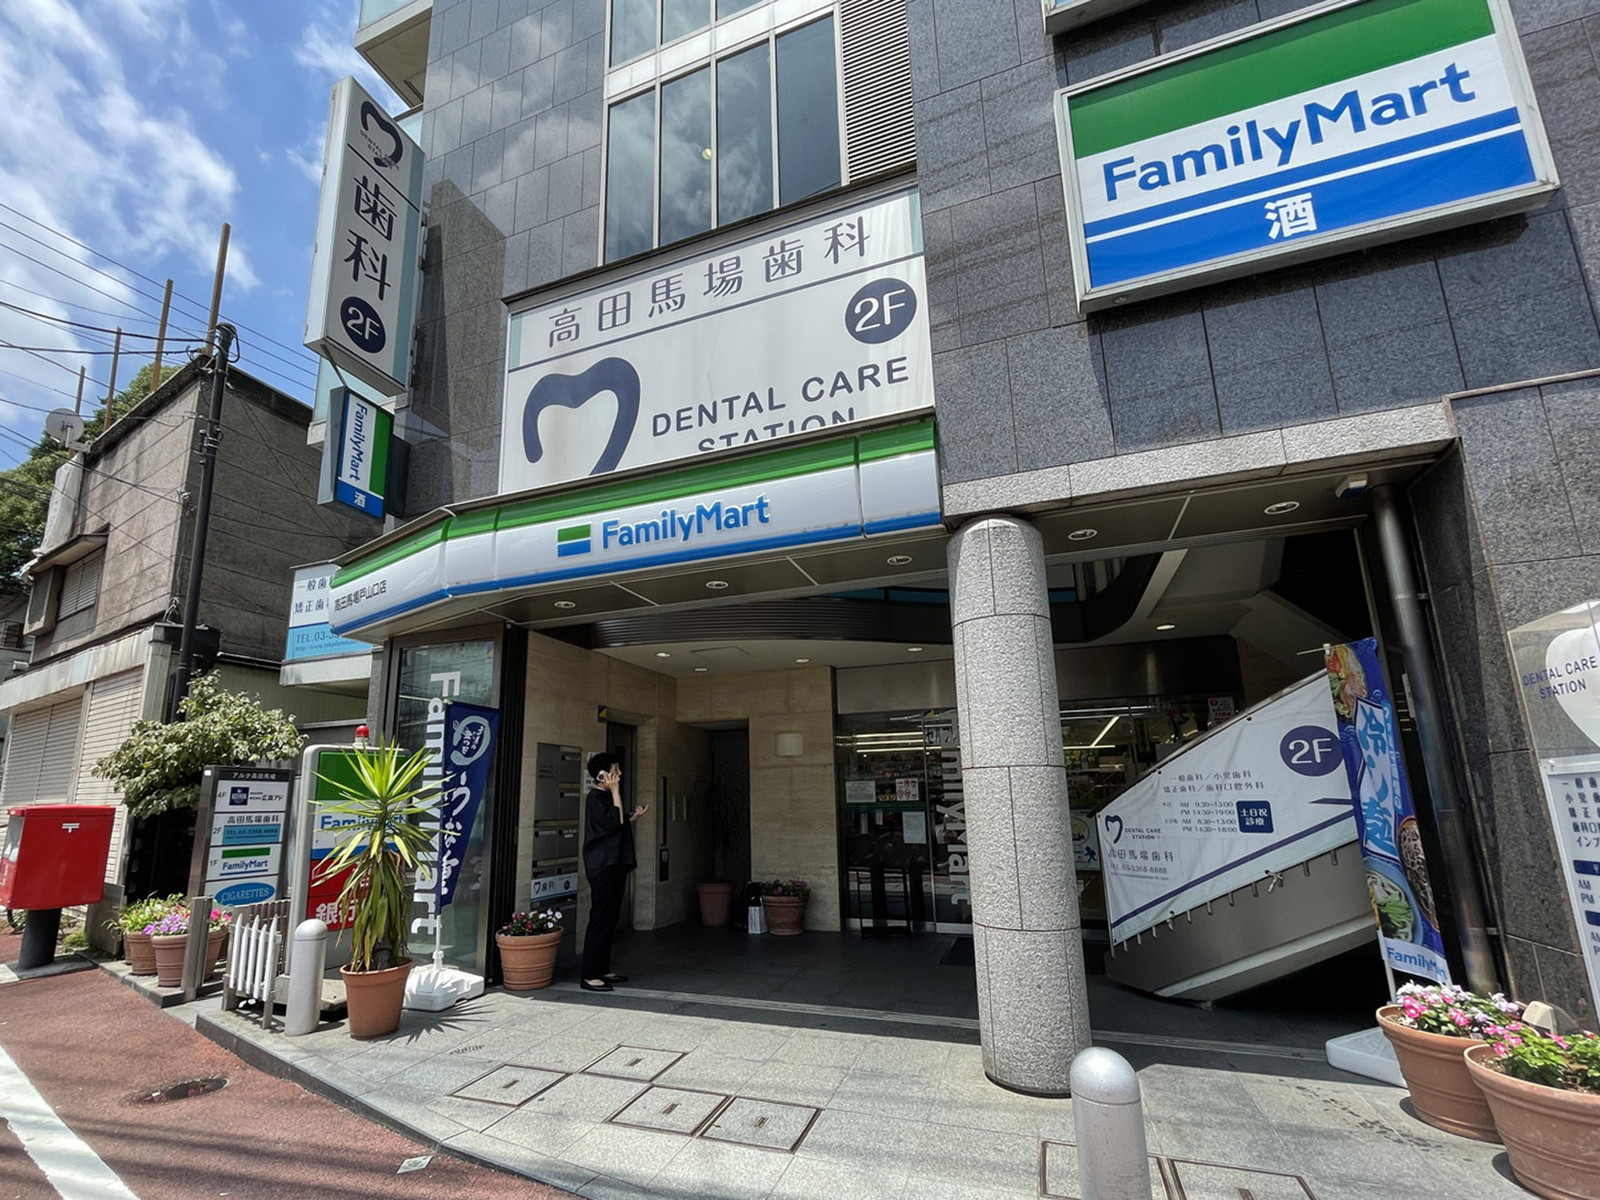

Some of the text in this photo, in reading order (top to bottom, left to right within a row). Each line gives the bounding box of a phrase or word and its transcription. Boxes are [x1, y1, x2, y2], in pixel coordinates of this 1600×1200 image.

[1103, 62, 1476, 202] FamilyMart
[1264, 192, 1318, 239] 酒
[344, 175, 397, 301] 歯科
[548, 215, 870, 349] 高田馬場歯科
[854, 288, 906, 333] 2F
[346, 306, 390, 340] 2F
[652, 356, 909, 437] DENTAL CARE
[349, 402, 368, 482] FamilyMart
[602, 495, 769, 549] FamilyMart
[294, 599, 329, 615] 矯正歯
[1523, 656, 1598, 686] DENTAL CARE
[1540, 678, 1587, 699] STATION
[1288, 737, 1333, 764] 2F
[227, 815, 279, 824] 高田馬場歯科
[1241, 808, 1268, 817] 土日祝
[1245, 817, 1265, 826] 診療
[213, 826, 222, 834] 2F
[1572, 822, 1600, 833] 歯科口
[210, 859, 218, 867] 1F
[1108, 848, 1174, 862] 高田馬場歯科
[223, 859, 268, 871] FamilyMart
[1578, 879, 1592, 890] AM
[221, 888, 270, 901] CIGARETTES
[1580, 893, 1595, 904] PM
